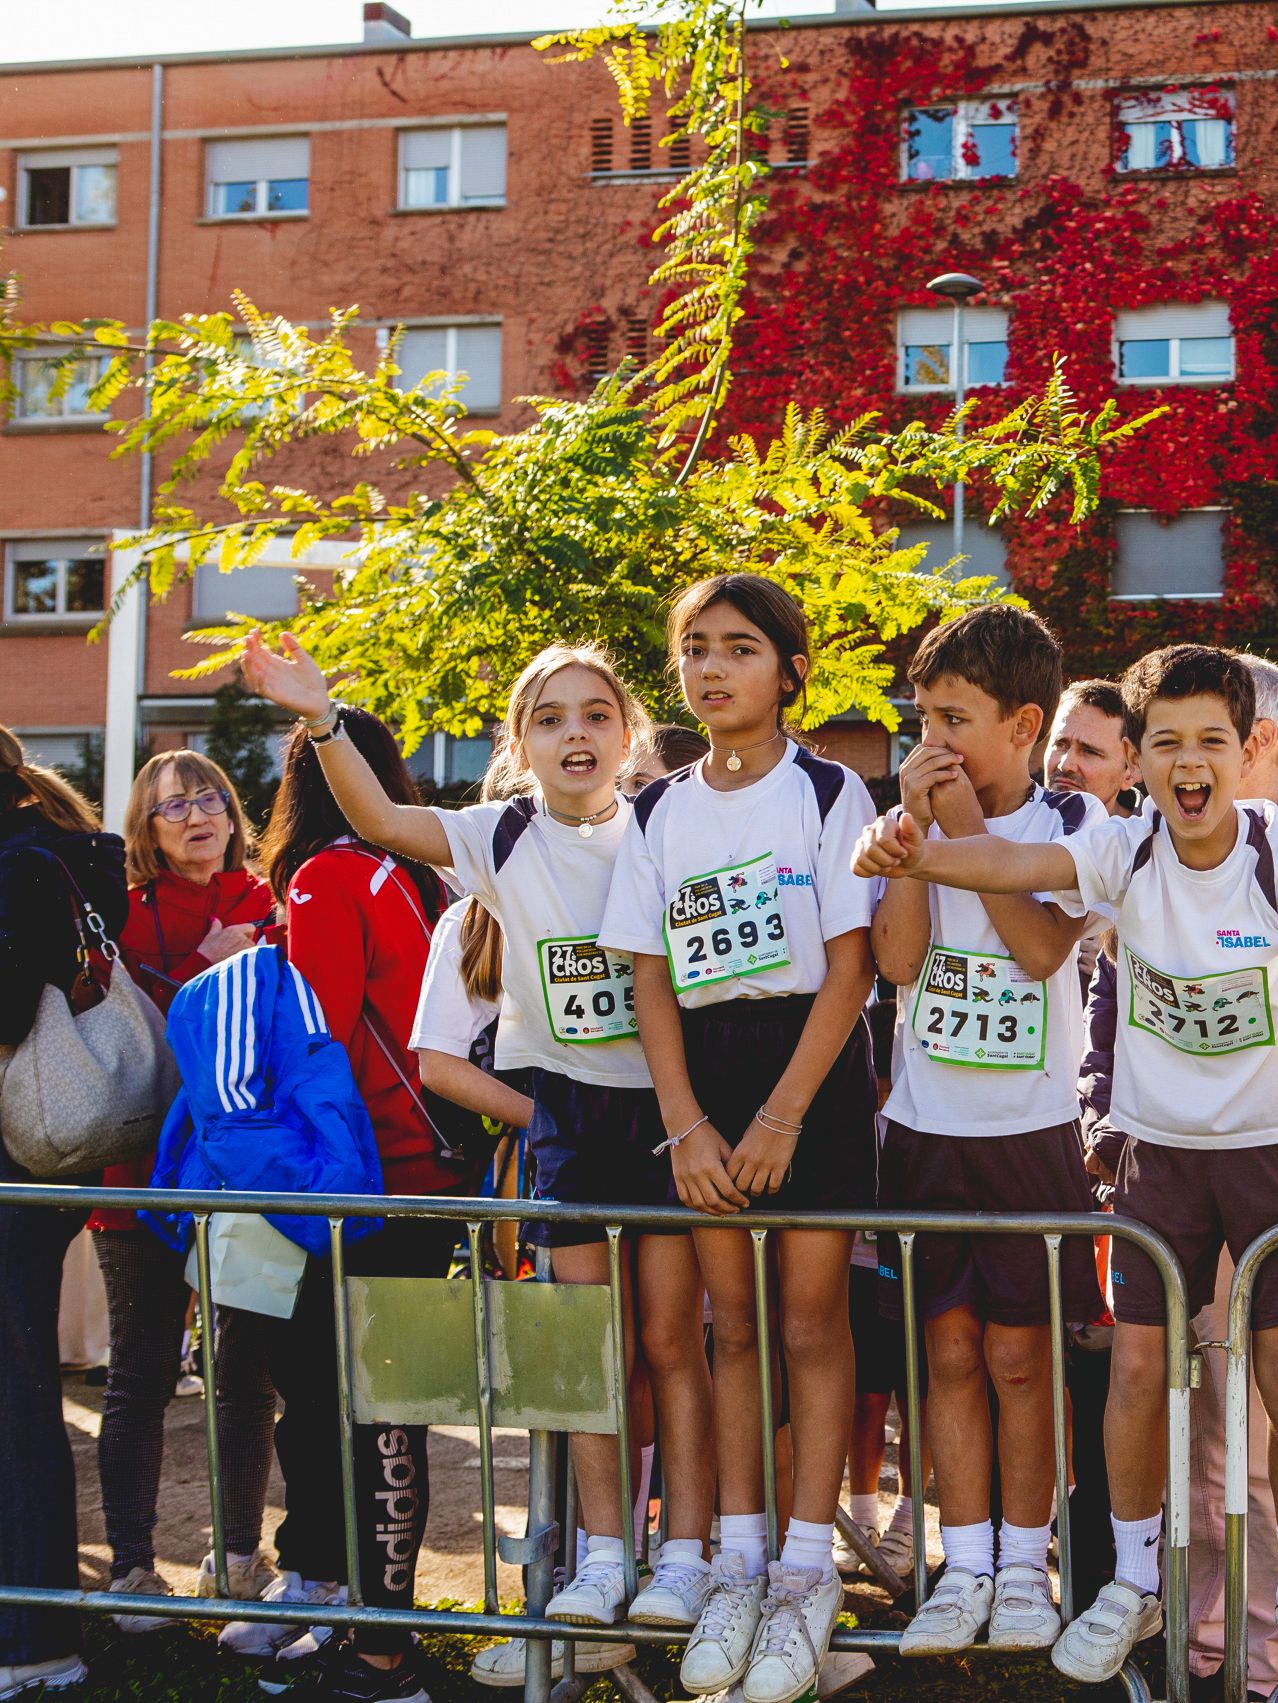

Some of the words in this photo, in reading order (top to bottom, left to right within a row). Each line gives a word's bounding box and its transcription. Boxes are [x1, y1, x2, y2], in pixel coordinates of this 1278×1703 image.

[777, 874, 813, 886] SABE
[672, 893, 721, 921] CROS
[686, 913, 785, 964] 2693
[1217, 936, 1271, 948] ISABEL
[552, 956, 605, 977] CROS
[930, 968, 965, 991] CROS
[927, 1006, 1018, 1043] 2713
[1148, 999, 1240, 1039] 2712
[375, 1428, 419, 1592] adidas
